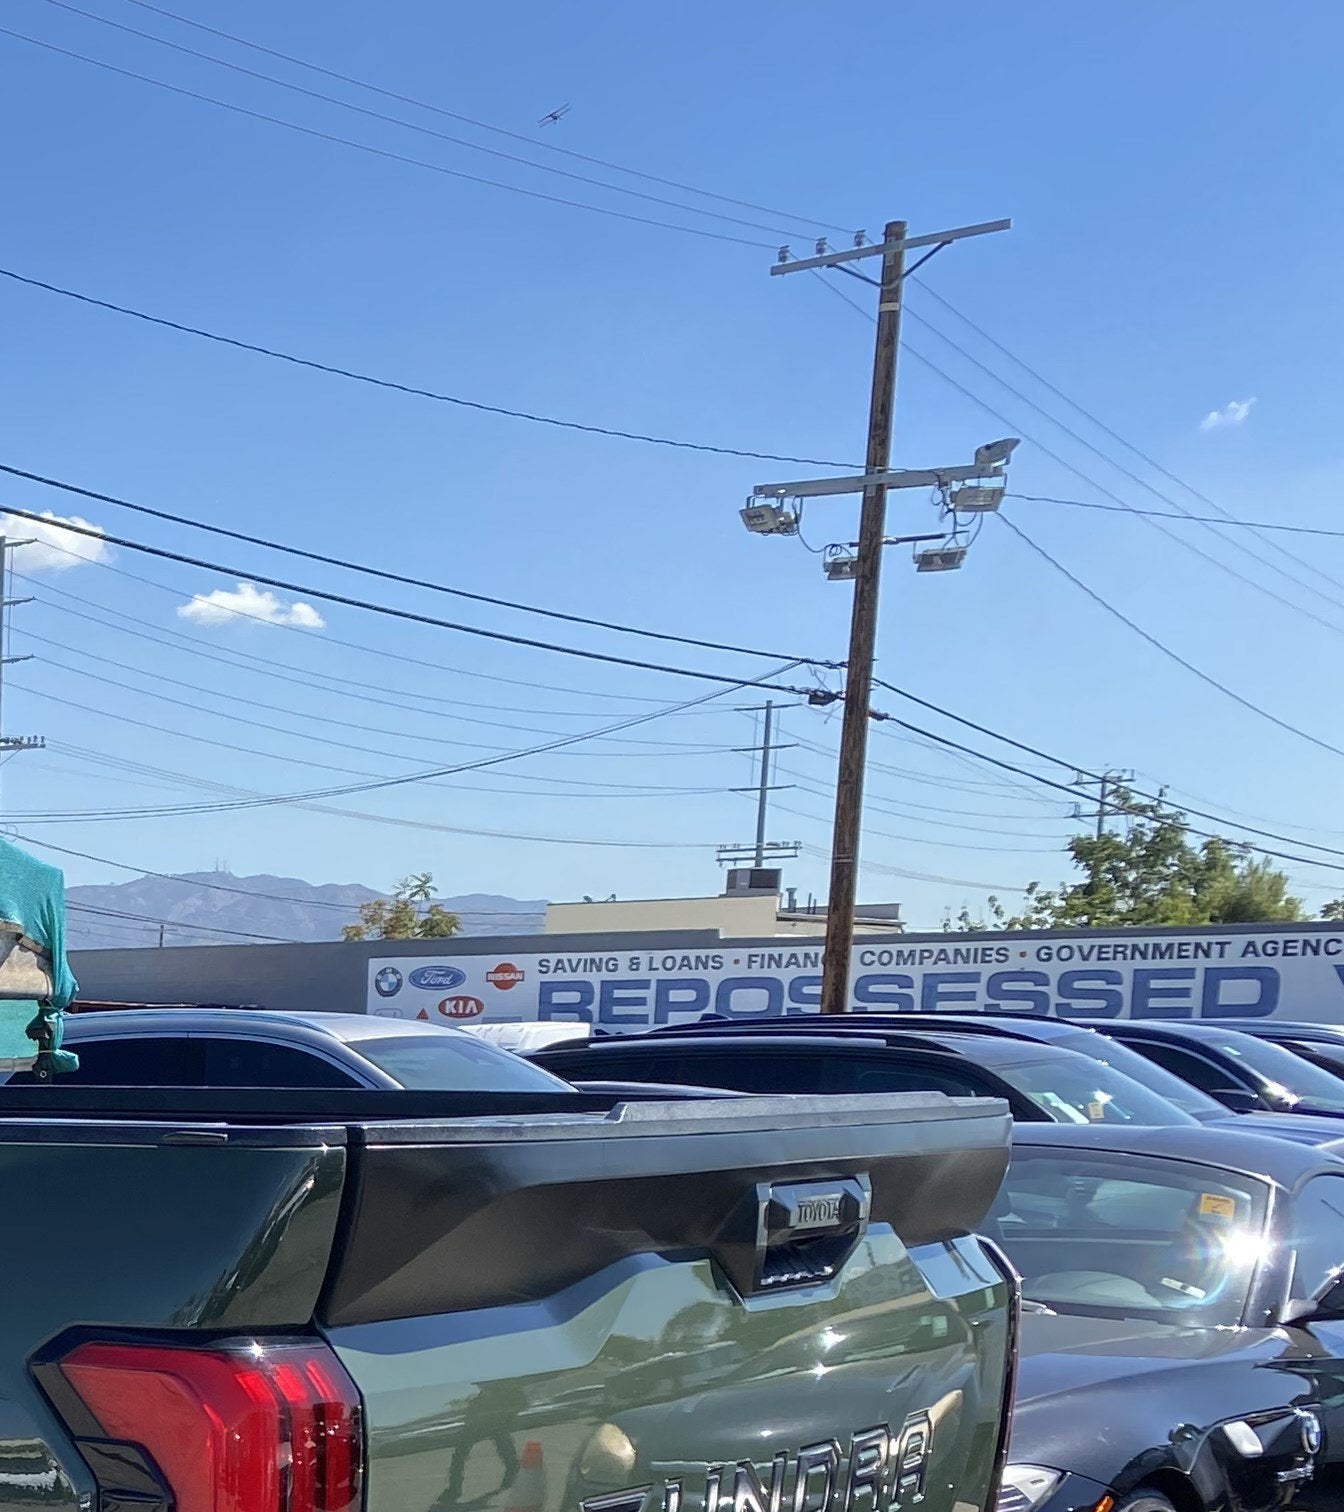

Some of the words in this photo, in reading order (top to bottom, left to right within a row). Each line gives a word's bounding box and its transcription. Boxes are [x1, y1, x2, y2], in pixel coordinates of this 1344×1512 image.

[537, 956, 619, 974] SAVING
[628, 956, 641, 972] &
[648, 954, 725, 971] LOANS
[746, 952, 825, 970] FINAN
[859, 946, 1010, 967] COMPANIES
[1036, 940, 1232, 963] GOVERNMENT
[419, 970, 454, 987] Ford
[487, 971, 524, 982] NISSAN
[443, 999, 478, 1015] KIA
[797, 1198, 840, 1223] TOYOTA
